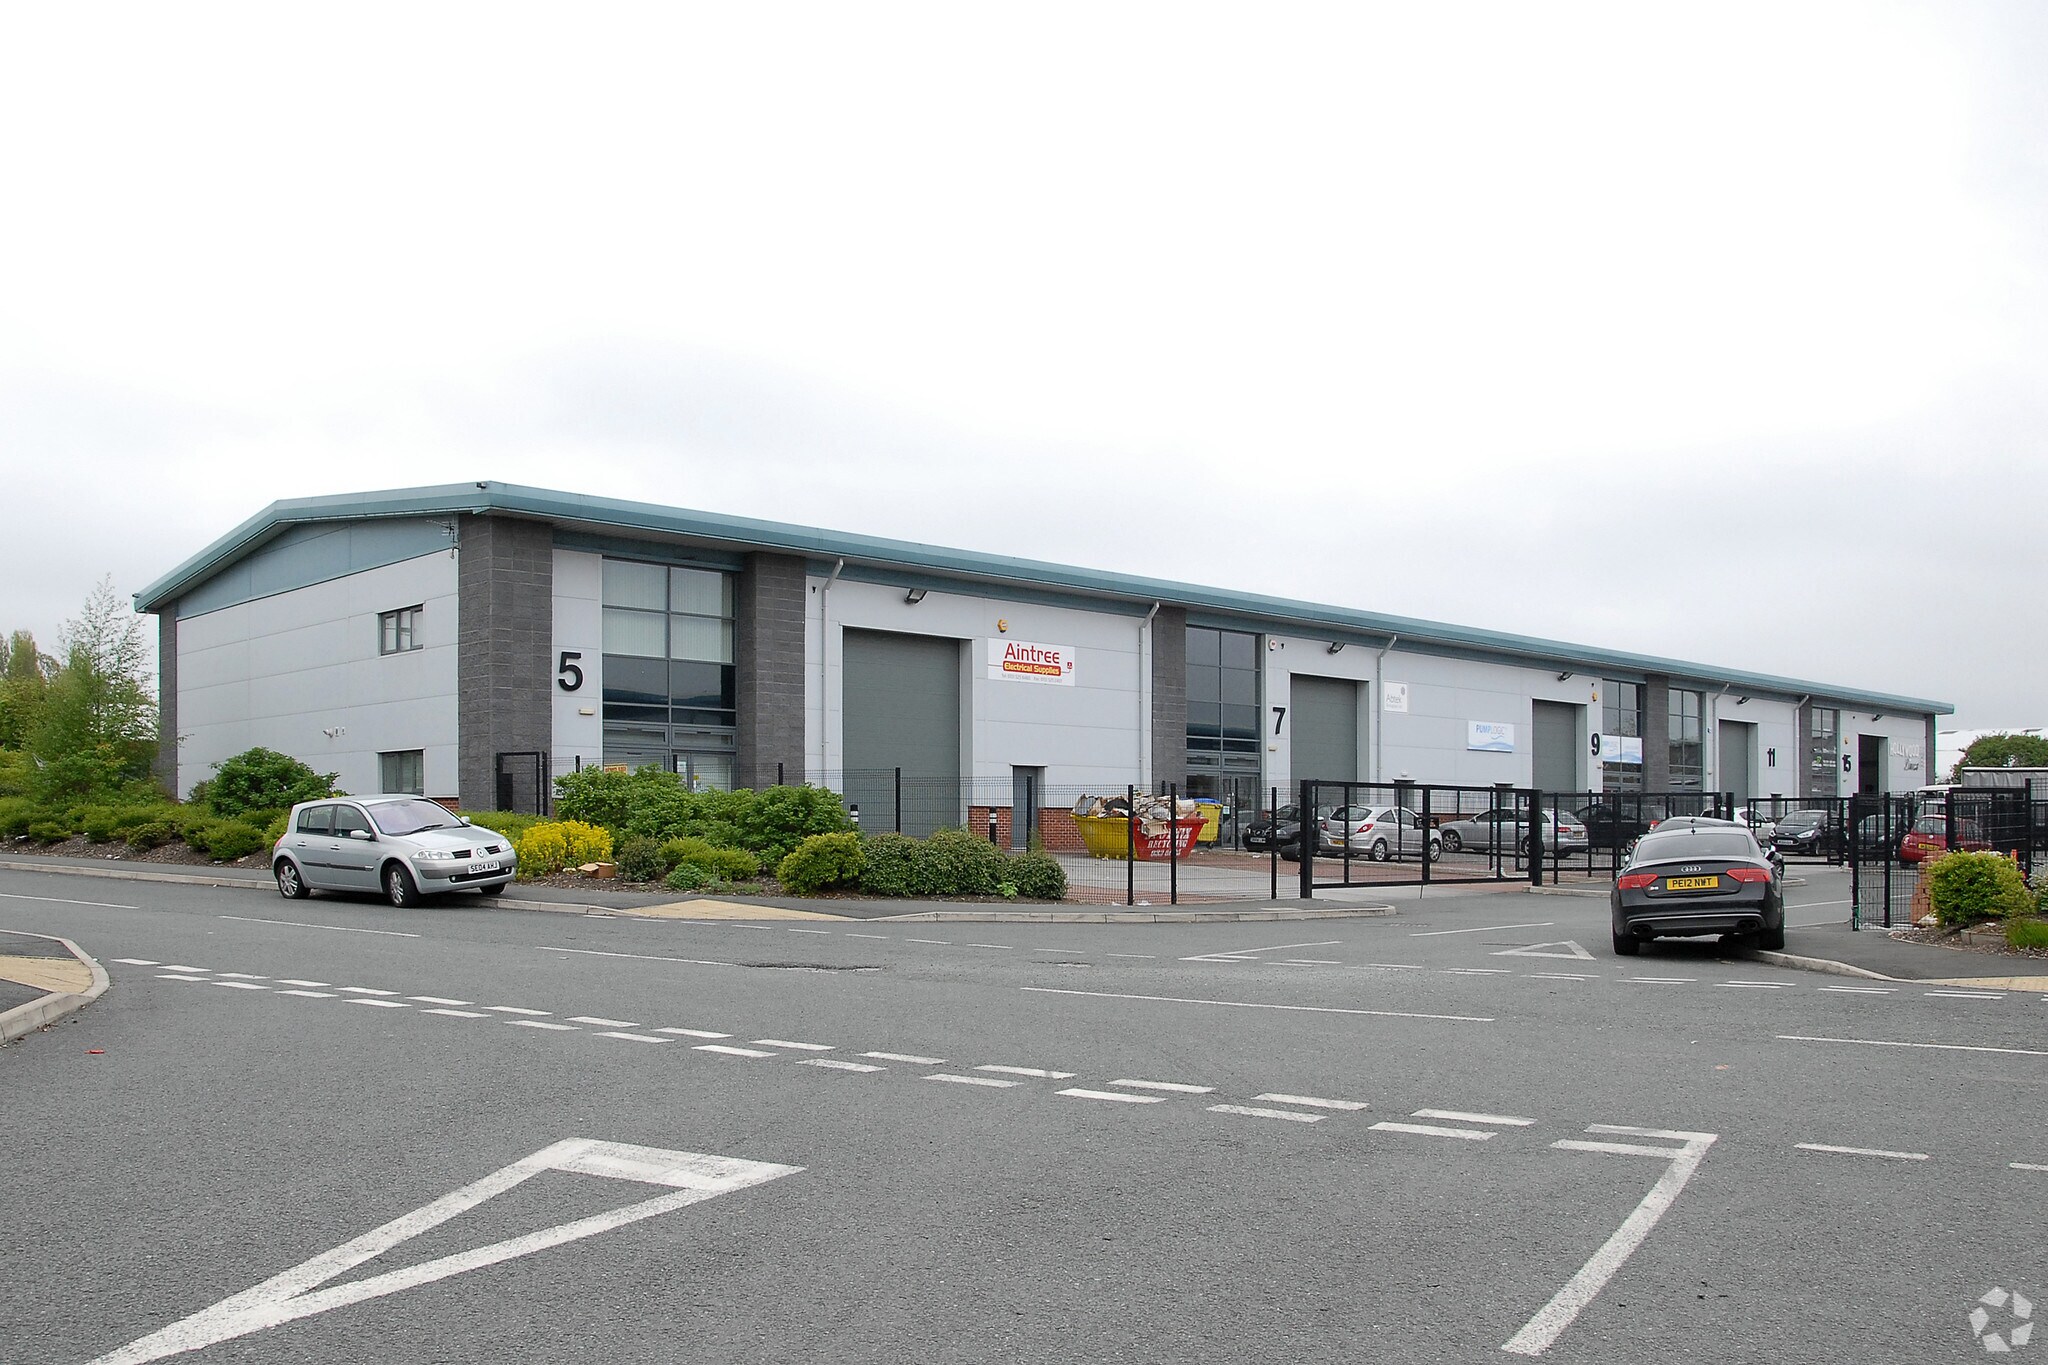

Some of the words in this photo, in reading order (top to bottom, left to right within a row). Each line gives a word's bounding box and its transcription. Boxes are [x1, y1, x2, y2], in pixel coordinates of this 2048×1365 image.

[1004, 642, 1060, 664] Aintree
[558, 652, 583, 692] 5
[1004, 663, 1032, 672] Electrical
[1034, 665, 1060, 675] Supplies
[1272, 707, 1286, 735] 7
[1591, 733, 1600, 756] 9
[1766, 747, 1776, 767] 11
[470, 864, 485, 872] SE04
[1672, 879, 1692, 888] PE12
